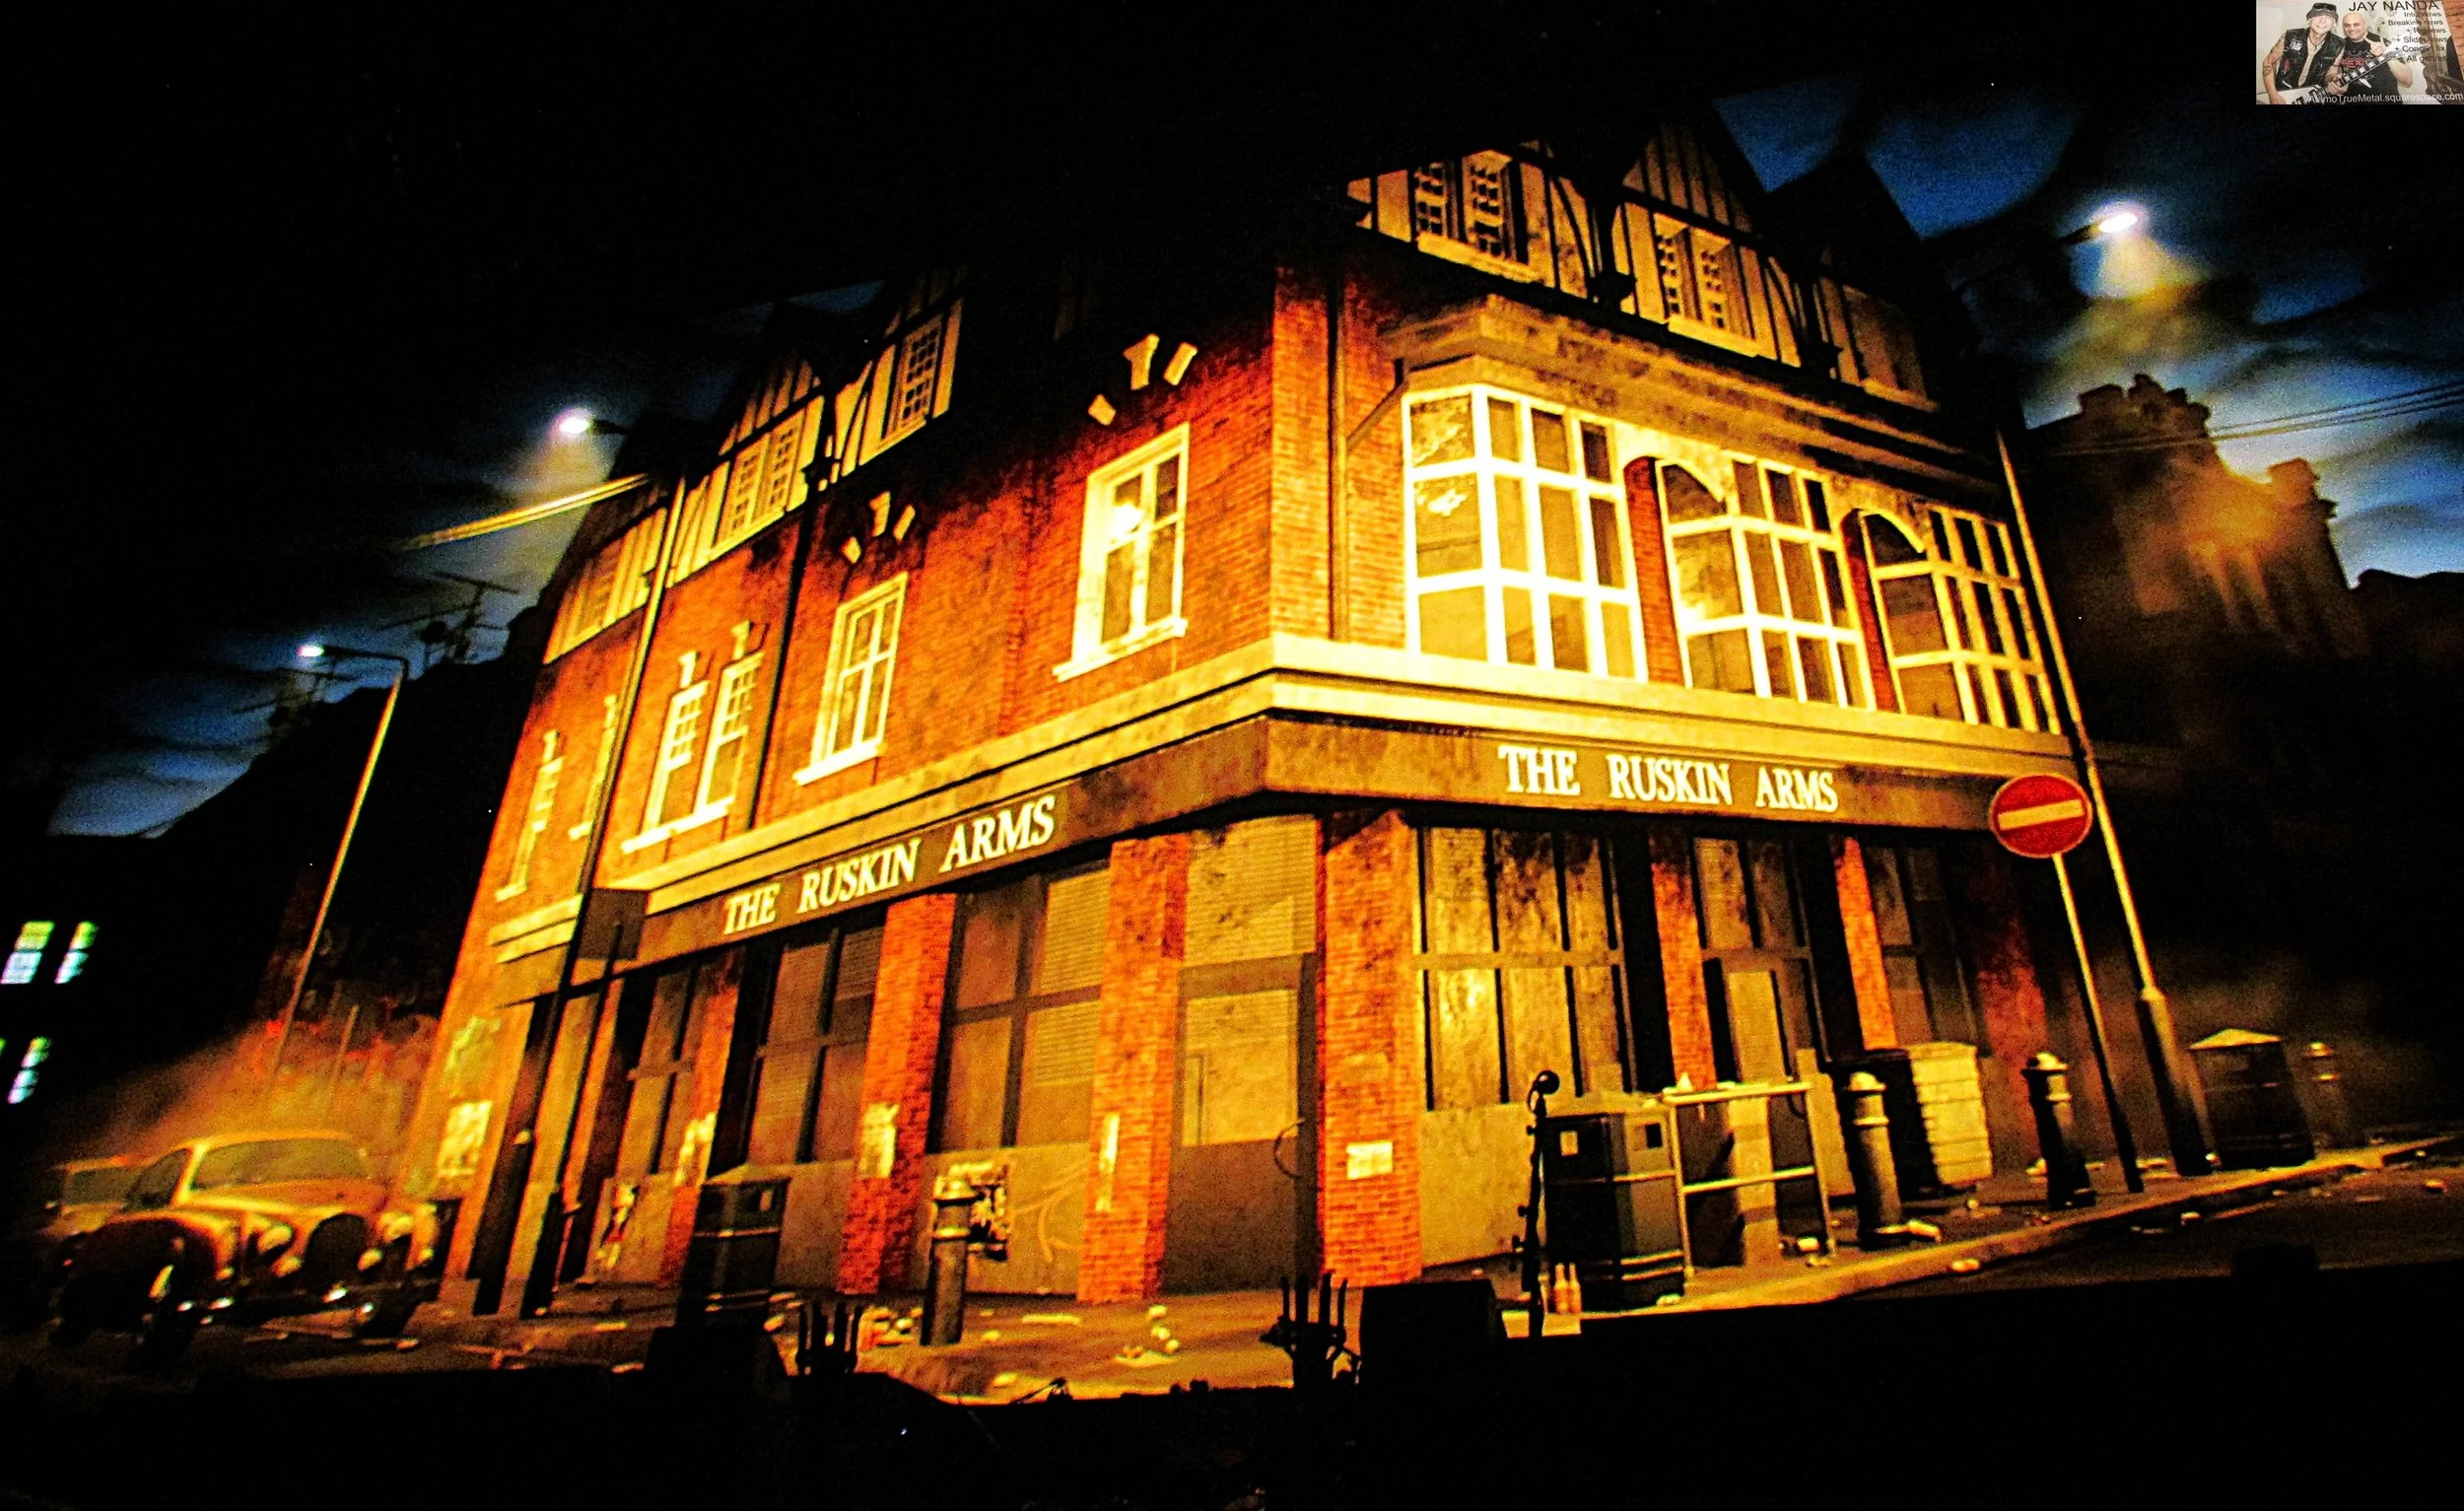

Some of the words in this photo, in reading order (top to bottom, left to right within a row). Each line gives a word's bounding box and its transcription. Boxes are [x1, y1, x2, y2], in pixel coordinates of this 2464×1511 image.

[1498, 745, 1581, 796] THE
[1607, 754, 1734, 806] RUSKIN
[1755, 766, 1838, 813] ARMS
[723, 882, 781, 935] THE
[797, 837, 922, 914] RUSKIN
[938, 794, 1057, 873] ARMS
